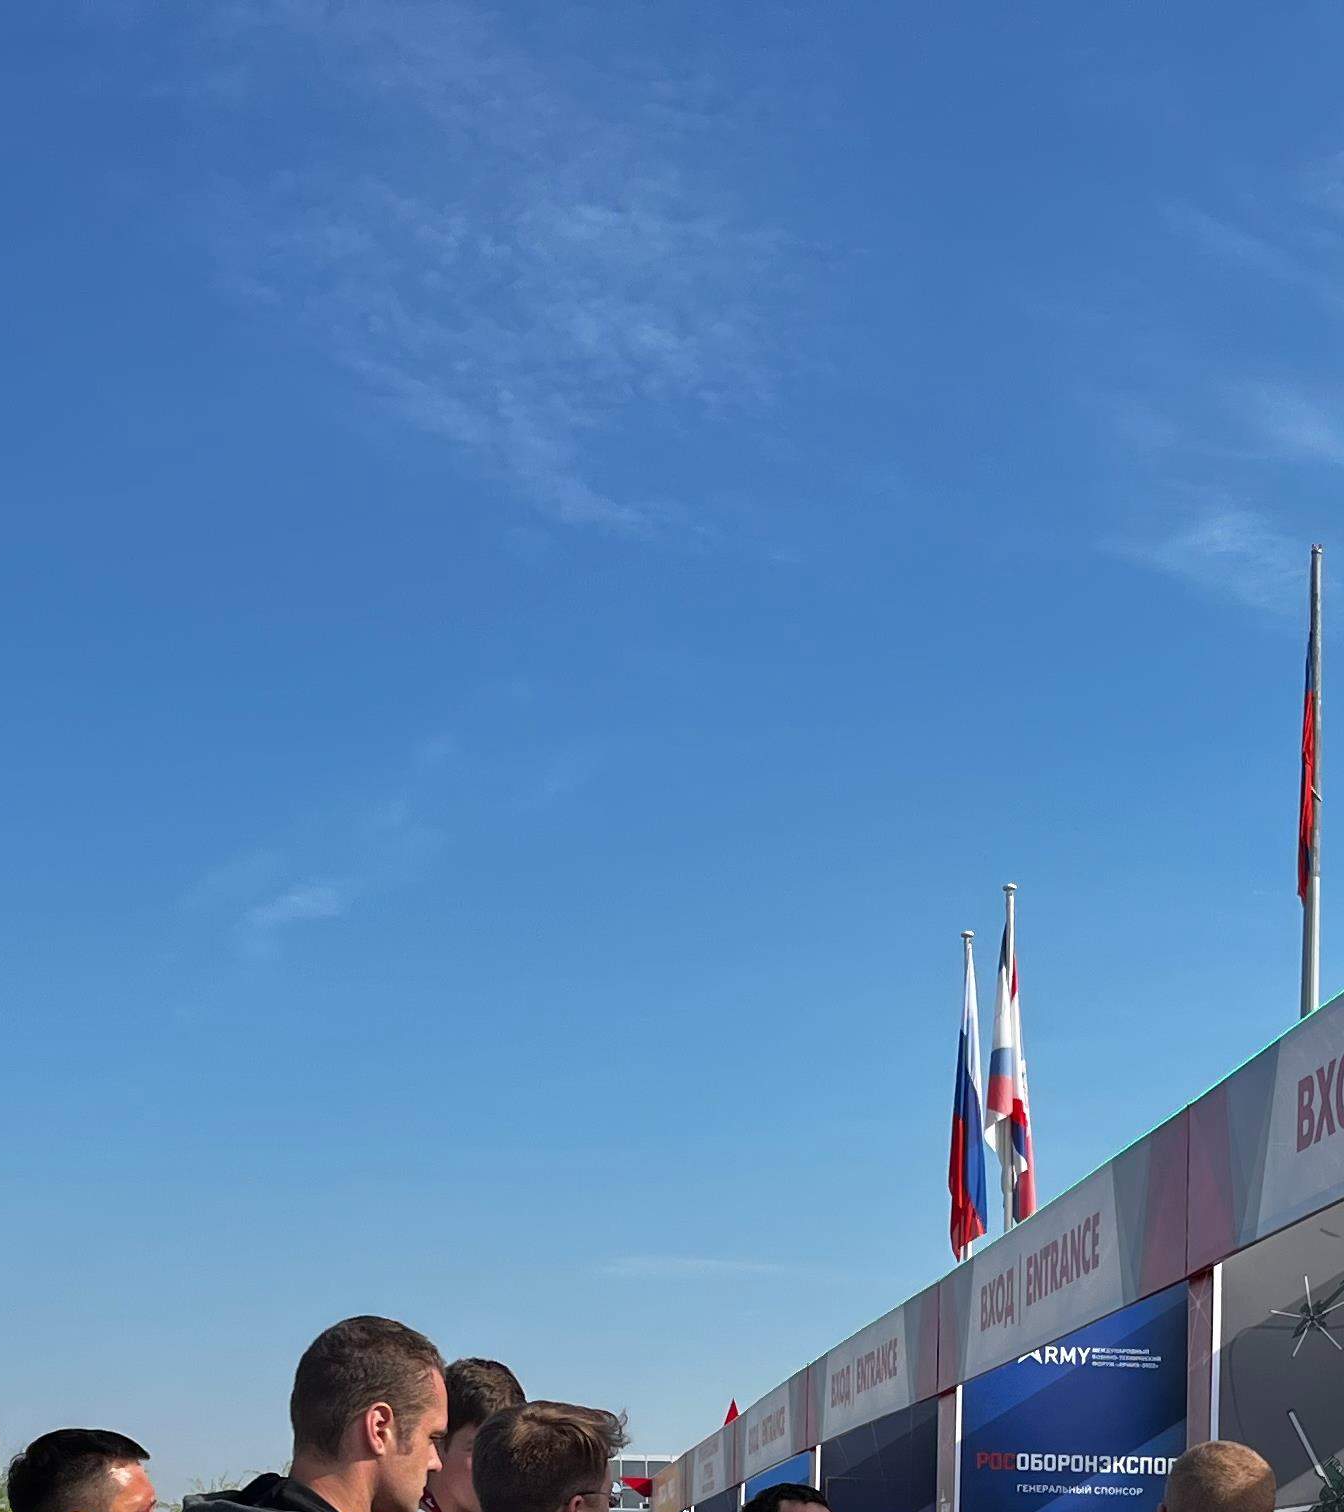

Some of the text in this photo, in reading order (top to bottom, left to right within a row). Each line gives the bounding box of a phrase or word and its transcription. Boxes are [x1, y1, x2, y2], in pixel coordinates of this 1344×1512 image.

[980, 1211, 1100, 1332] ВХОД ENTRANCE
[856, 1338, 898, 1395] ENTRANCE
[1016, 1484, 1144, 1496] ГЕНЕРАЛЬНЫЙ СПОНСОР
